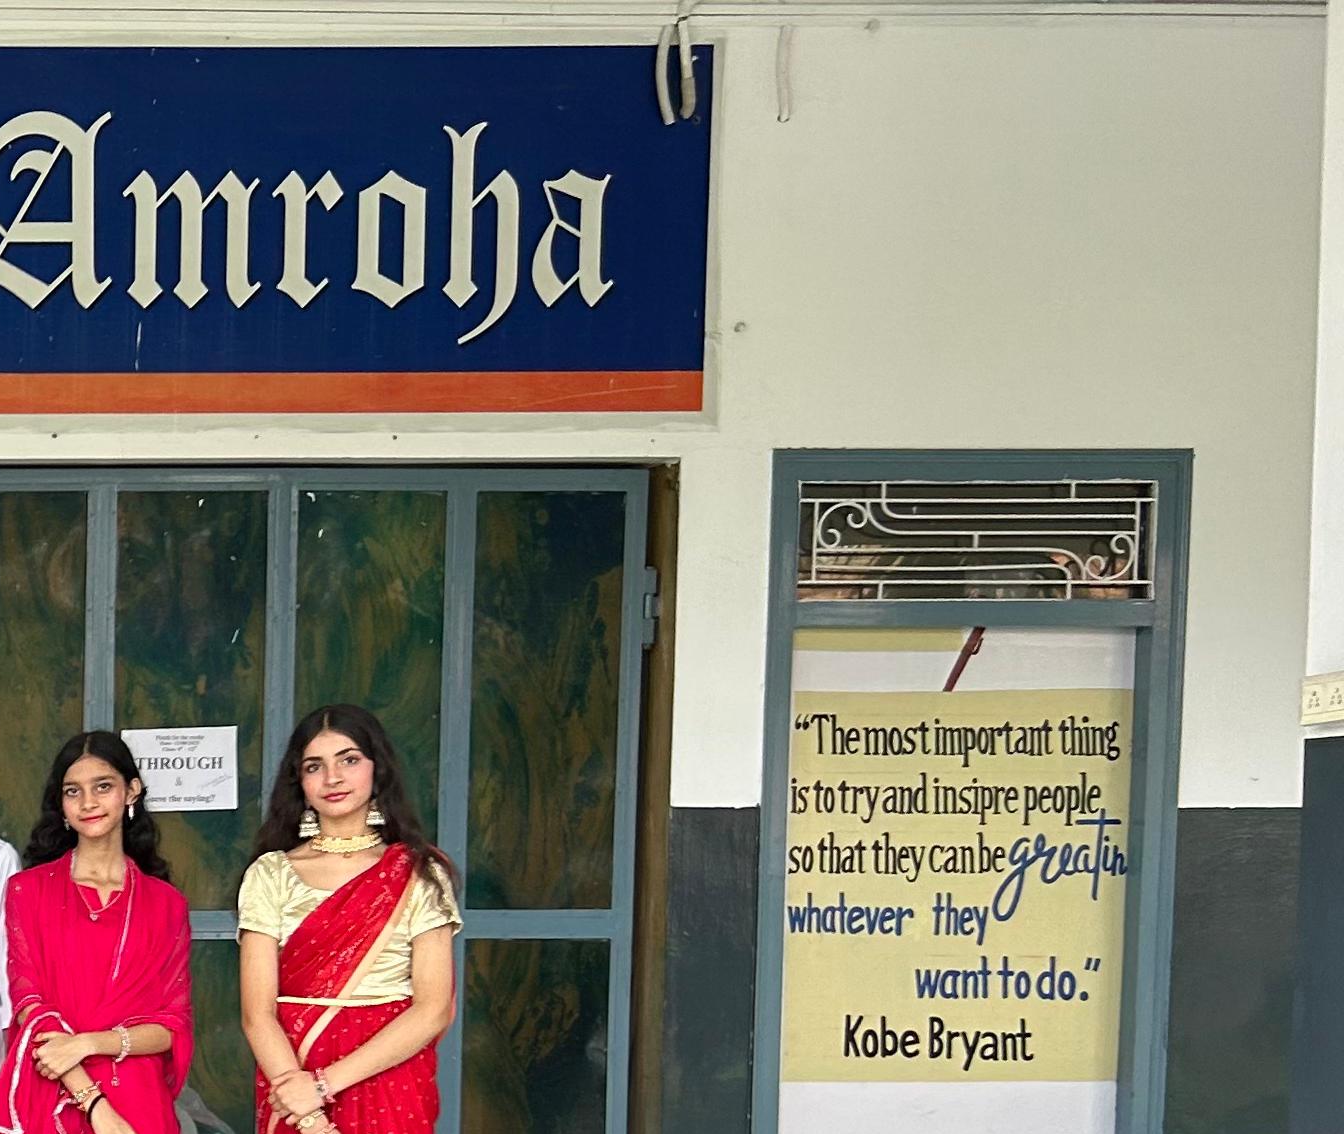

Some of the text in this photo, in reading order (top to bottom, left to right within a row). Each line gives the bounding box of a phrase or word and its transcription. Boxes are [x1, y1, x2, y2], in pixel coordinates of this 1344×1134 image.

[136, 756, 223, 770] THROUGH
[864, 721, 929, 756] most
[934, 717, 1053, 768] important
[1059, 715, 1121, 761] thing
[789, 777, 809, 815] is
[813, 779, 835, 814] to
[838, 779, 879, 824] try
[882, 772, 929, 815] and
[933, 777, 1019, 825] insipre
[788, 844, 812, 875] so
[817, 831, 867, 875] that
[872, 831, 925, 882] they
[928, 843, 976, 875] can
[977, 831, 1006, 874] be
[993, 808, 1122, 922] great
[787, 891, 988, 946] whatever they
[915, 955, 992, 1000] want
[997, 955, 1032, 1000] to
[843, 1013, 1034, 1072] Kobe Bryant
